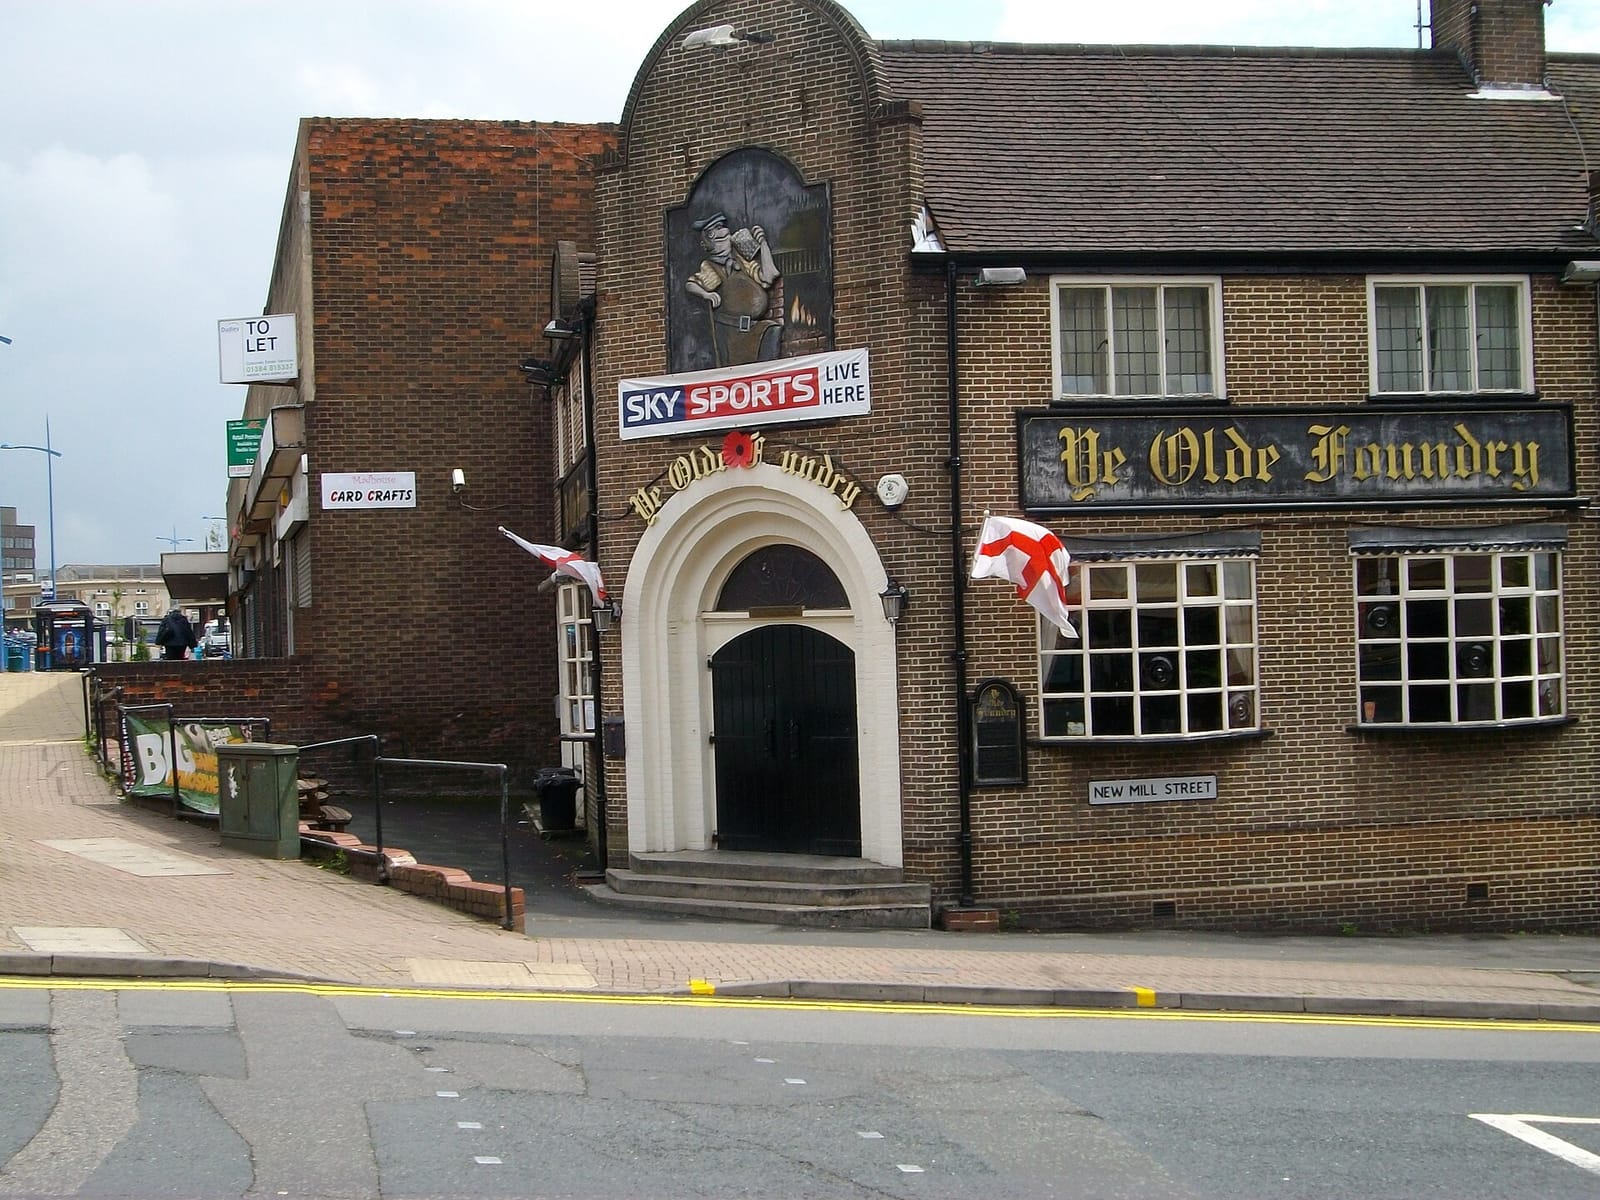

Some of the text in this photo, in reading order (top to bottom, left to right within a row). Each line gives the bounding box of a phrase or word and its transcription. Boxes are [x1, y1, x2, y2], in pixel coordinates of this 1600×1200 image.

[246, 320, 270, 335] TO
[246, 337, 278, 352] LET
[825, 362, 861, 382] LIVE
[626, 373, 815, 423] SKY SPORTS
[823, 384, 865, 405] HERE
[1058, 423, 1540, 501] Ye Olde Foundry
[331, 489, 413, 502] CARD CRAFTS
[630, 487, 662, 526] Ye
[136, 729, 196, 786] BIG
[1094, 781, 1212, 798] NEW MILL STREET
